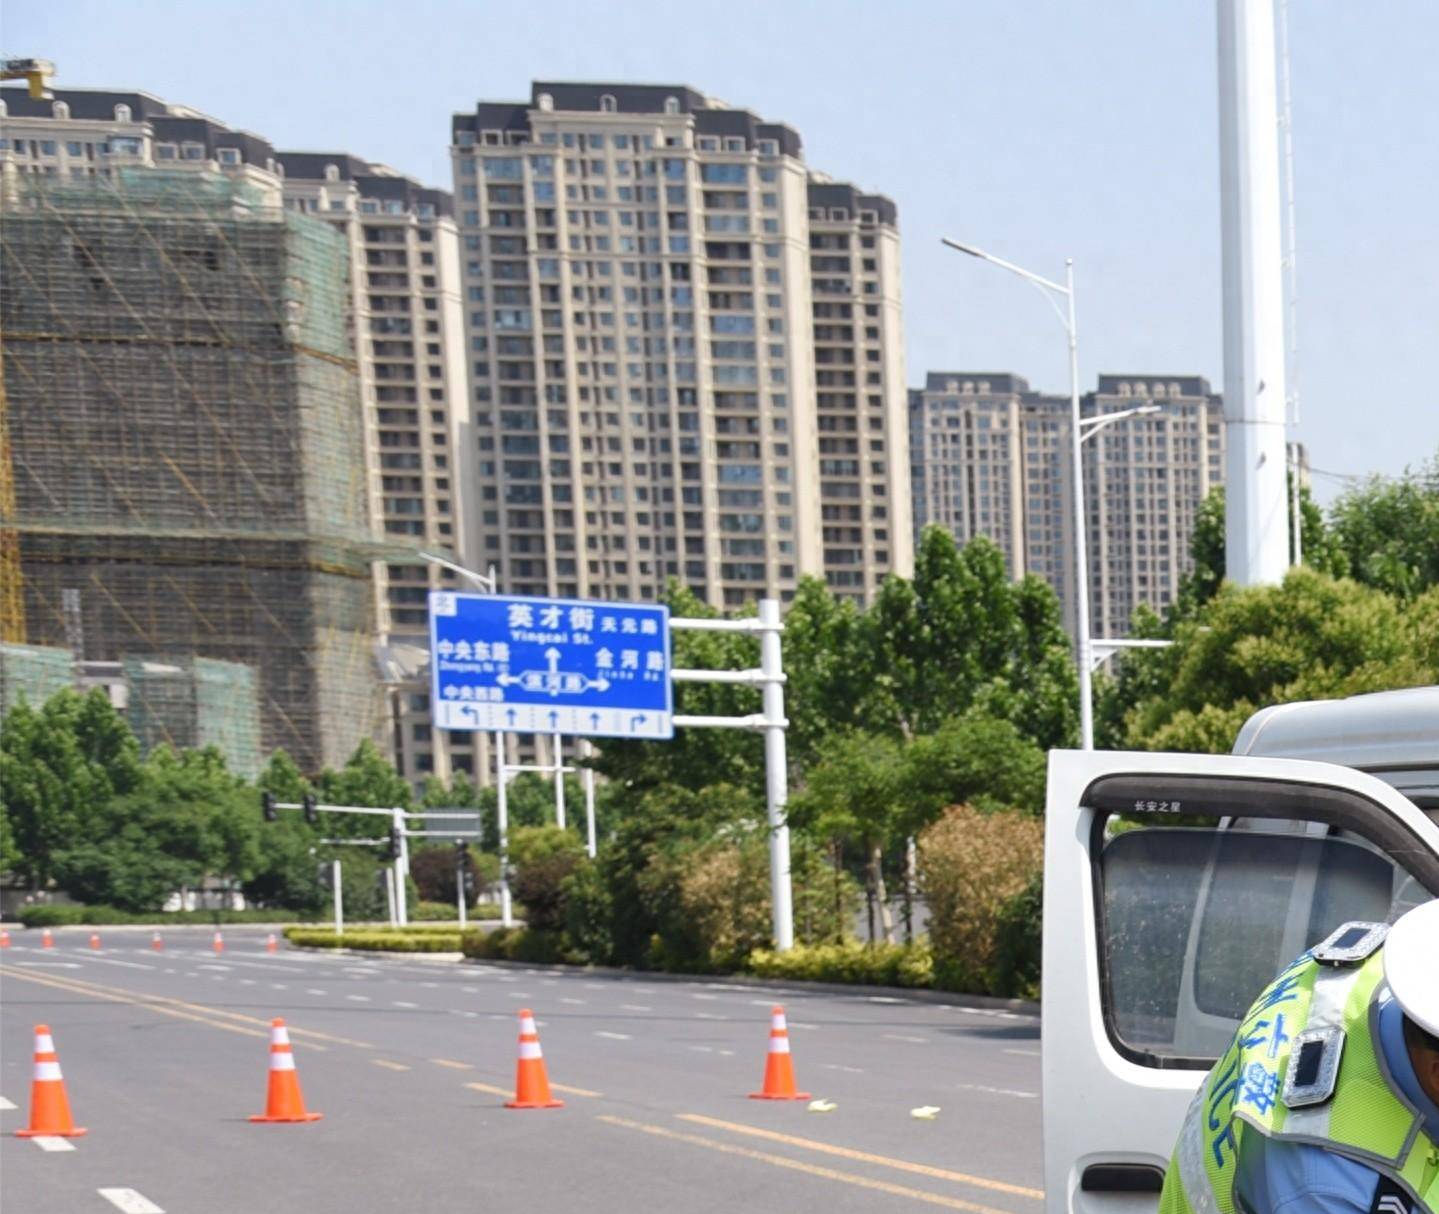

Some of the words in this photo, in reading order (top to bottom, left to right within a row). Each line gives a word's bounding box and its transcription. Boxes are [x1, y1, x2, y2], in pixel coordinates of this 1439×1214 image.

[507, 604, 594, 632] 英才街
[510, 630, 568, 646] Yingcai
[438, 640, 510, 662] 中央东路
[595, 647, 664, 672] 金河路
[443, 684, 504, 702] 中央西路
[1134, 800, 1181, 813] 长安之星
